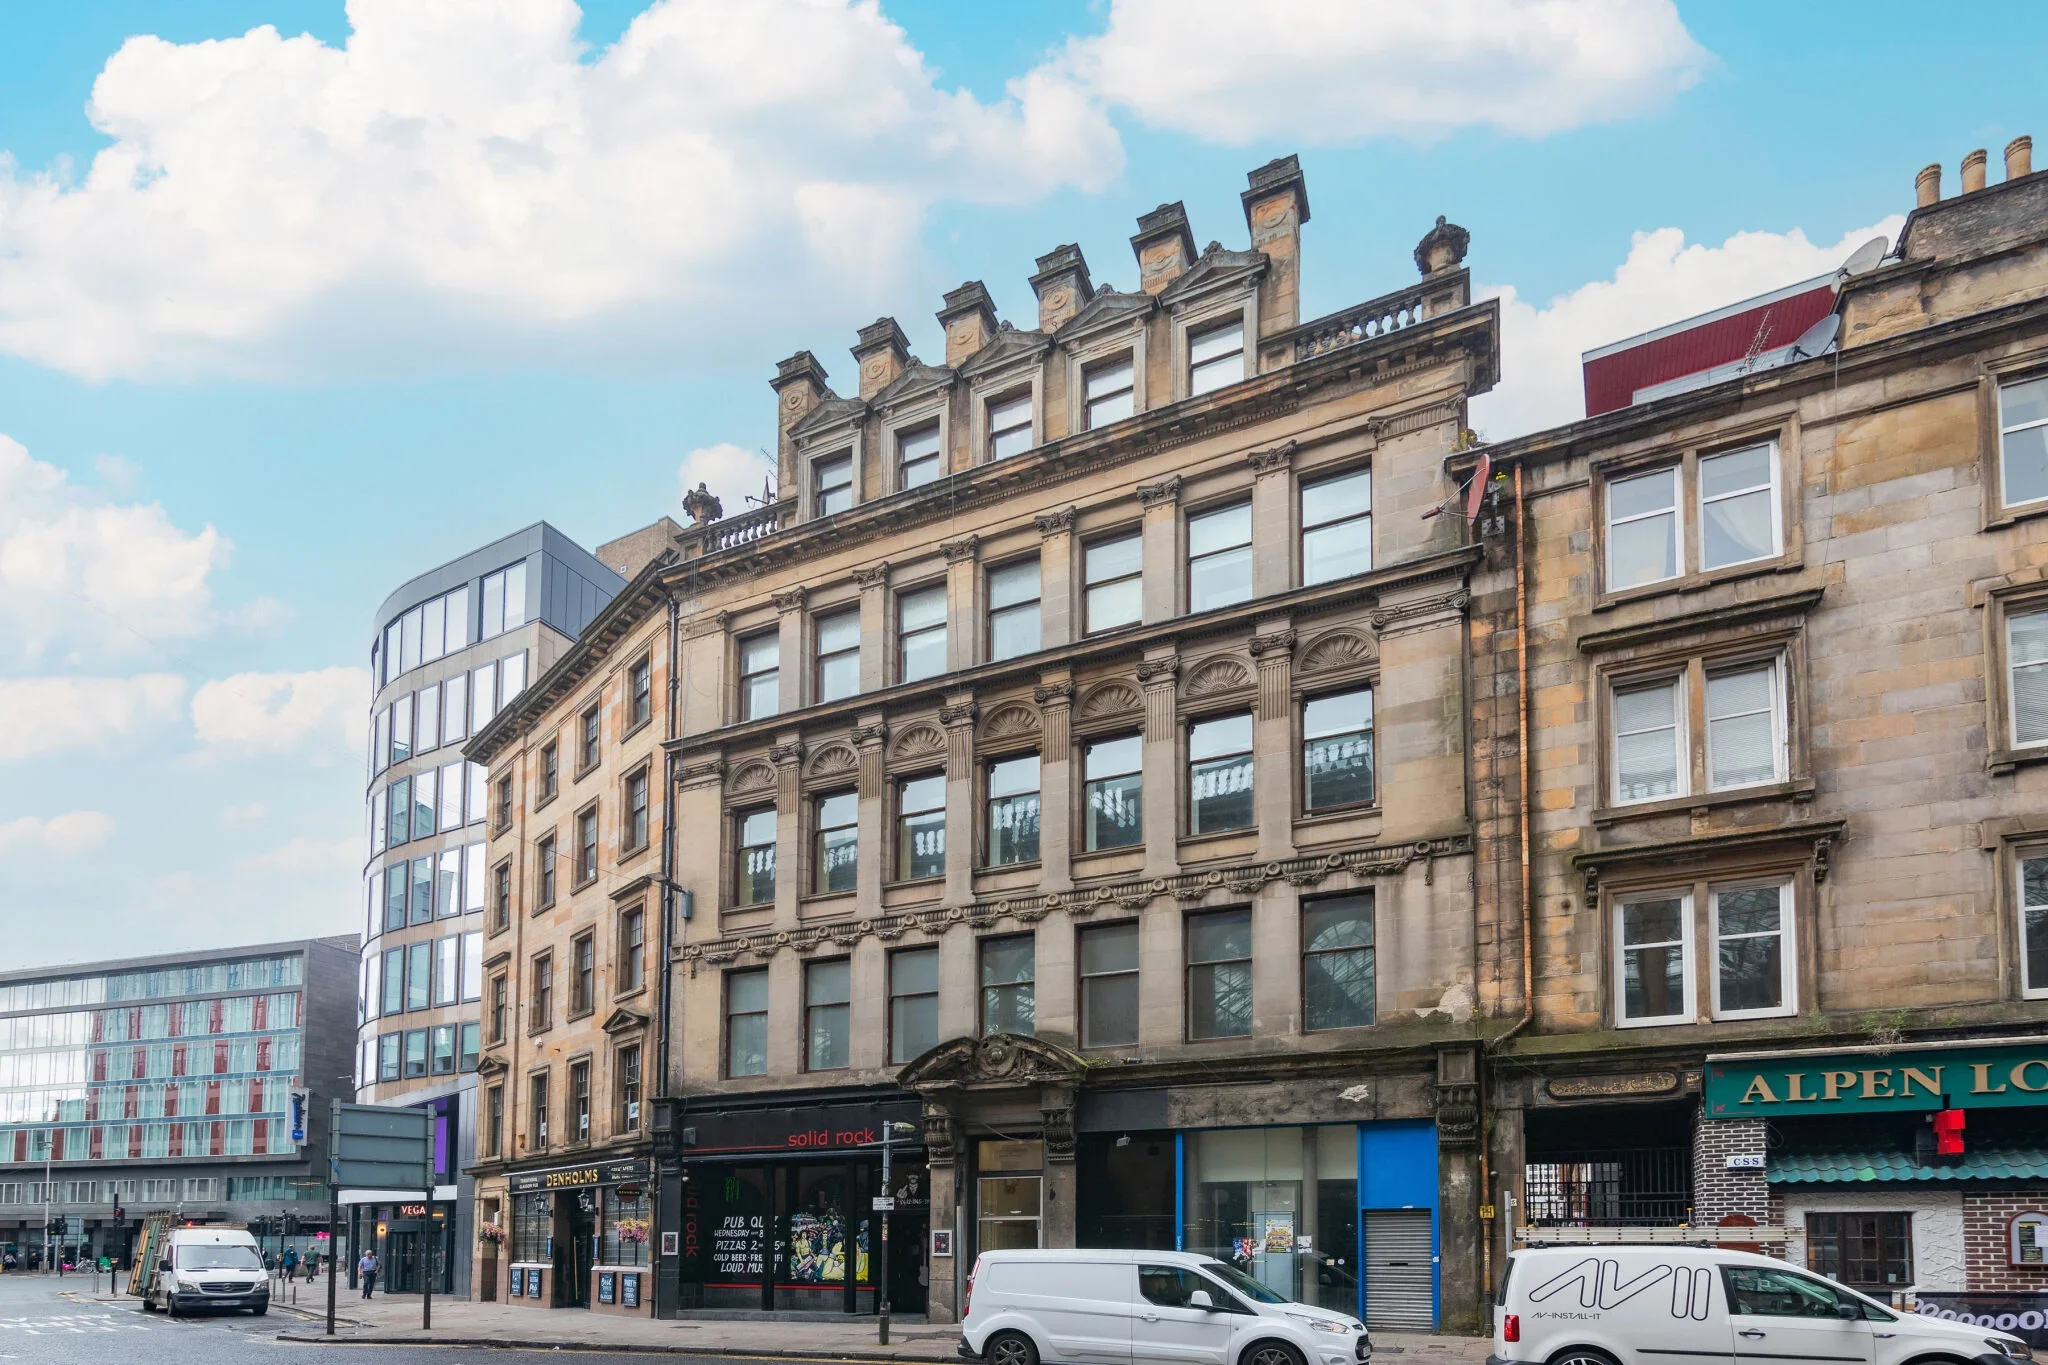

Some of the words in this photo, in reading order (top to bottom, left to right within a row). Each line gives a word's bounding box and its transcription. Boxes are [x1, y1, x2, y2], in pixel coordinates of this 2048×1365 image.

[1739, 1066, 1946, 1104] ALPEN
[788, 1129, 829, 1147] solid
[836, 1127, 875, 1145] rock
[546, 1169, 599, 1187] DENHOLMS
[401, 1205, 426, 1215] VEGA
[724, 1216, 745, 1229] PUB
[714, 1229, 750, 1238] WEDNESDAY
[715, 1240, 746, 1251] PIZZAS
[713, 1253, 730, 1262] COLD
[1531, 1312, 1601, 1320] AV-INSTALL-IT
